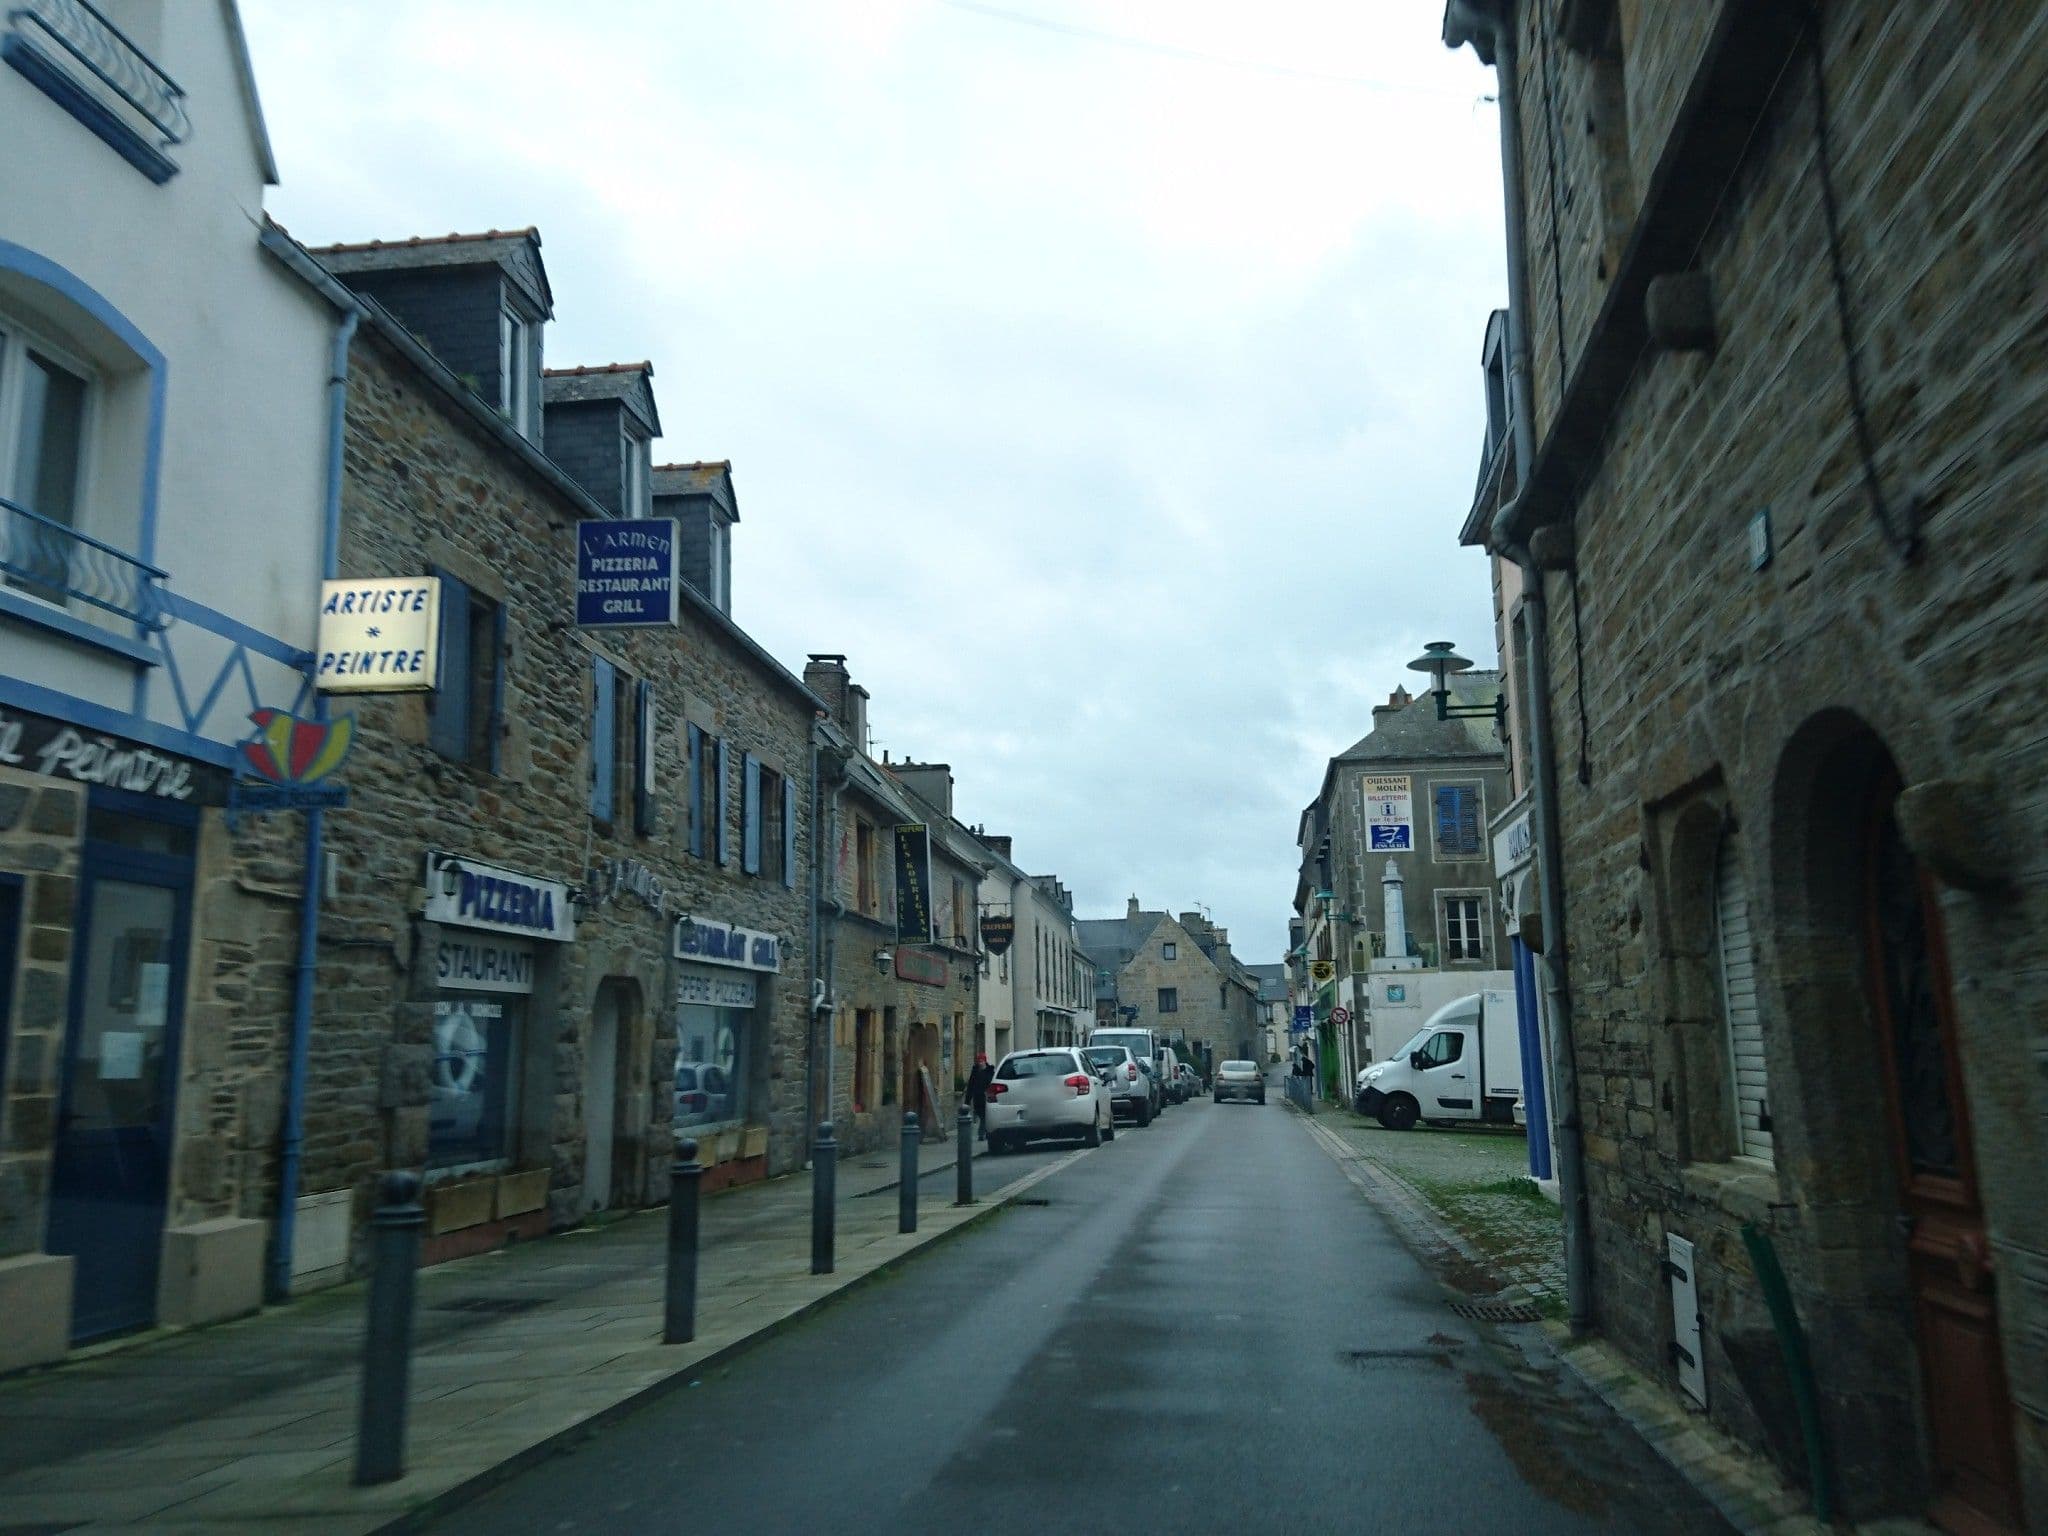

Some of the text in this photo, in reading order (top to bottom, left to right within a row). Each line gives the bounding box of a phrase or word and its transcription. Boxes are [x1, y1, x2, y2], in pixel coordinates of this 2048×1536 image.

[591, 557, 658, 572] PIZZERIA
[580, 577, 670, 592] RESTAURANT
[323, 589, 428, 614] ARTISTE
[602, 599, 644, 613] GRILL
[319, 649, 425, 675] PEINTRE
[459, 870, 555, 931] PIZZERIA
[438, 943, 533, 984] STAURANT
